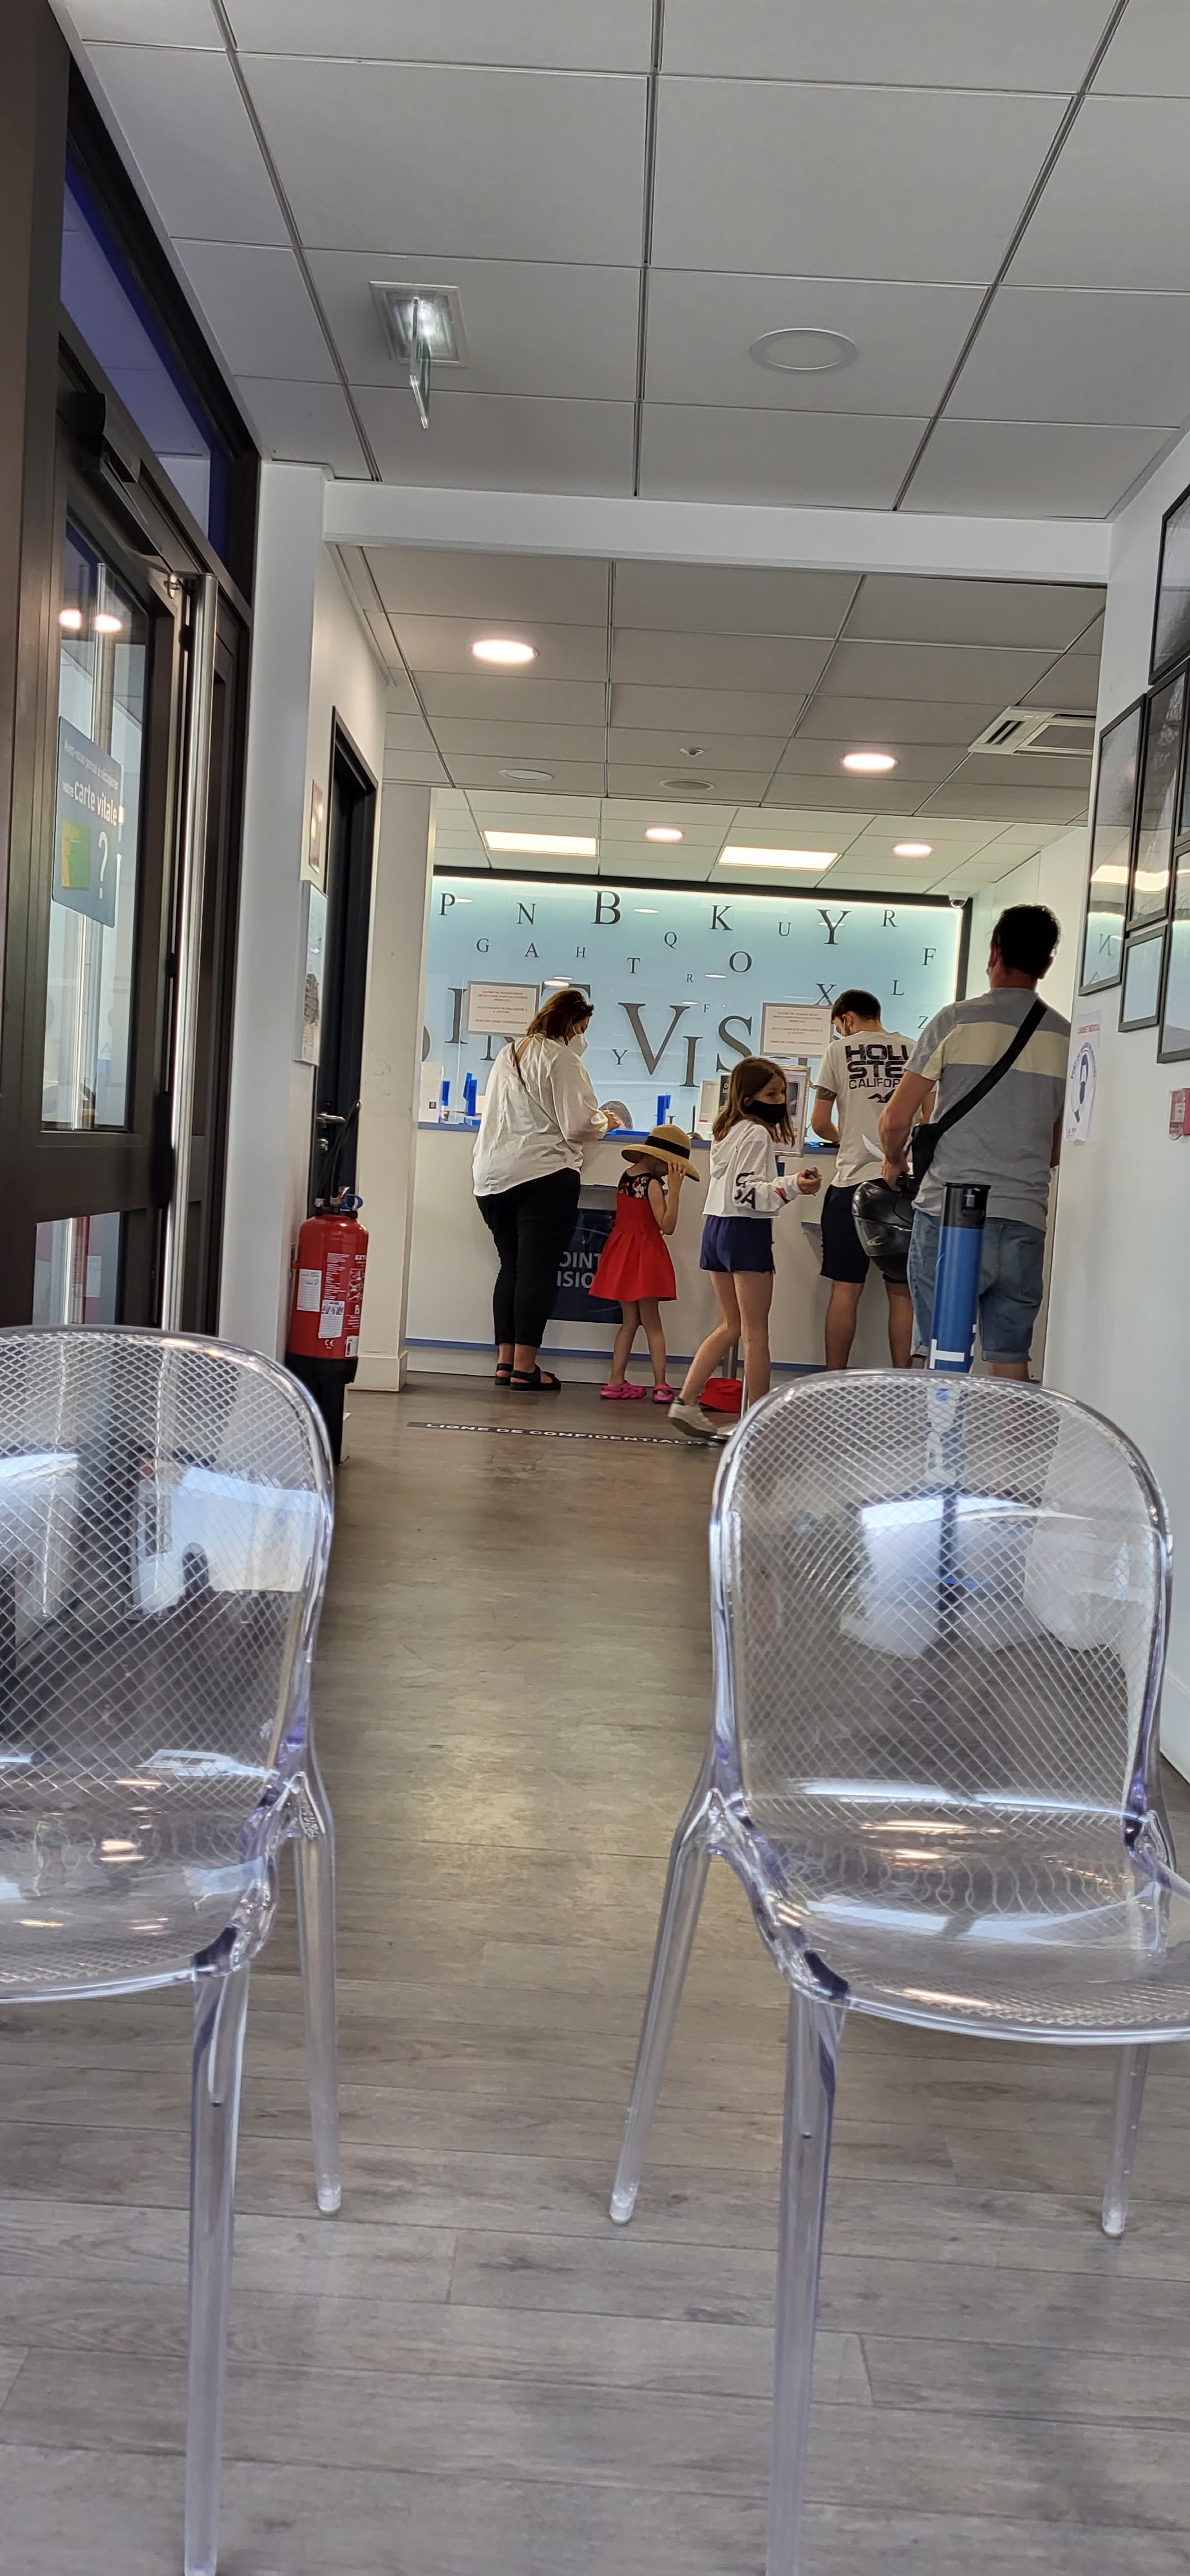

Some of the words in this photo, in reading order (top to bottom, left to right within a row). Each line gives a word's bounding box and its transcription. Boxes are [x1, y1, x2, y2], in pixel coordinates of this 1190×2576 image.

[74, 781, 95, 812] carte
[97, 792, 117, 826] vitale
[438, 893, 455, 916] P
[516, 902, 537, 925] N
[591, 890, 621, 925] B
[709, 904, 733, 931] K
[882, 909, 898, 927] R
[778, 922, 791, 936] U
[817, 909, 852, 945] Y
[476, 938, 490, 952] G
[664, 931, 677, 949] Q
[524, 942, 539, 958] A
[576, 947, 586, 958] H
[921, 947, 936, 965] F
[627, 957, 641, 974] T
[729, 951, 752, 972] O
[891, 980, 905, 996] L
[611, 1048, 629, 1065] Y
[847, 1060, 907, 1079] STE
